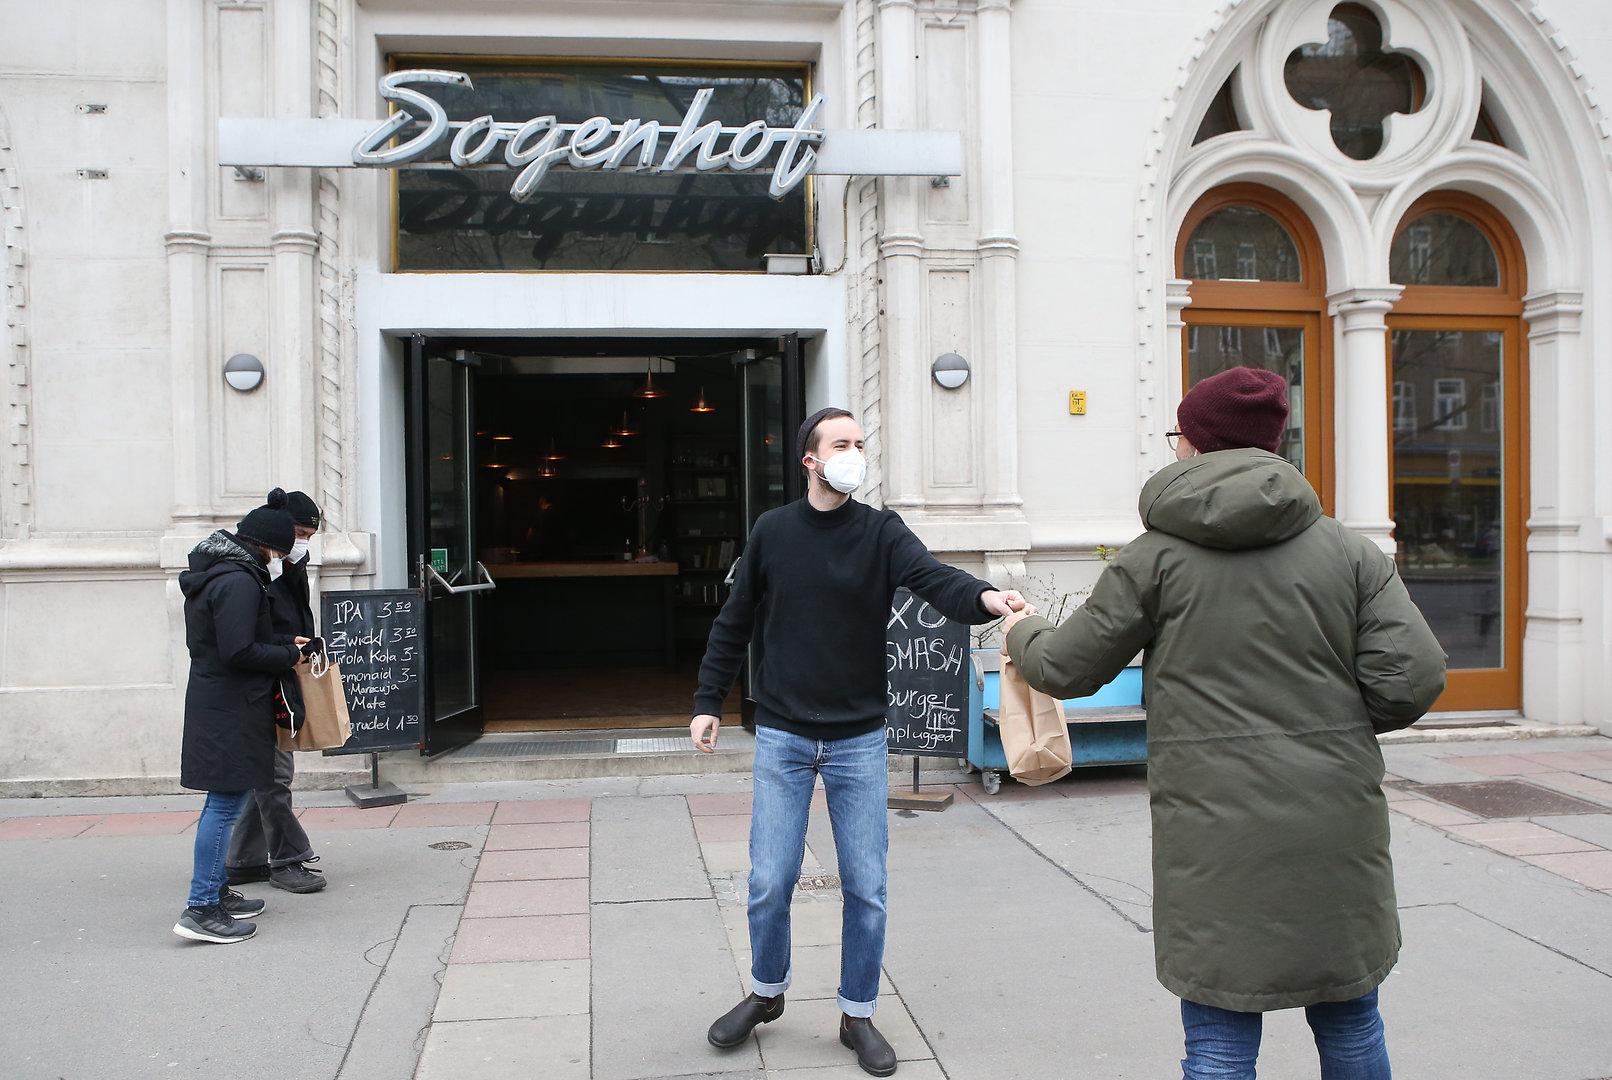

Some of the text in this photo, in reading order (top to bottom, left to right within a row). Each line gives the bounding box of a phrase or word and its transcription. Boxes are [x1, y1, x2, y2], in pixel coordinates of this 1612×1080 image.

[333, 600, 364, 625] IPA
[328, 649, 365, 665] Tirola
[370, 649, 397, 665] Kola
[886, 637, 963, 675] SMASH
[340, 667, 392, 684] emonaid
[351, 696, 387, 712] Mate
[349, 716, 390, 732] prudel
[886, 724, 955, 749] nplugged
